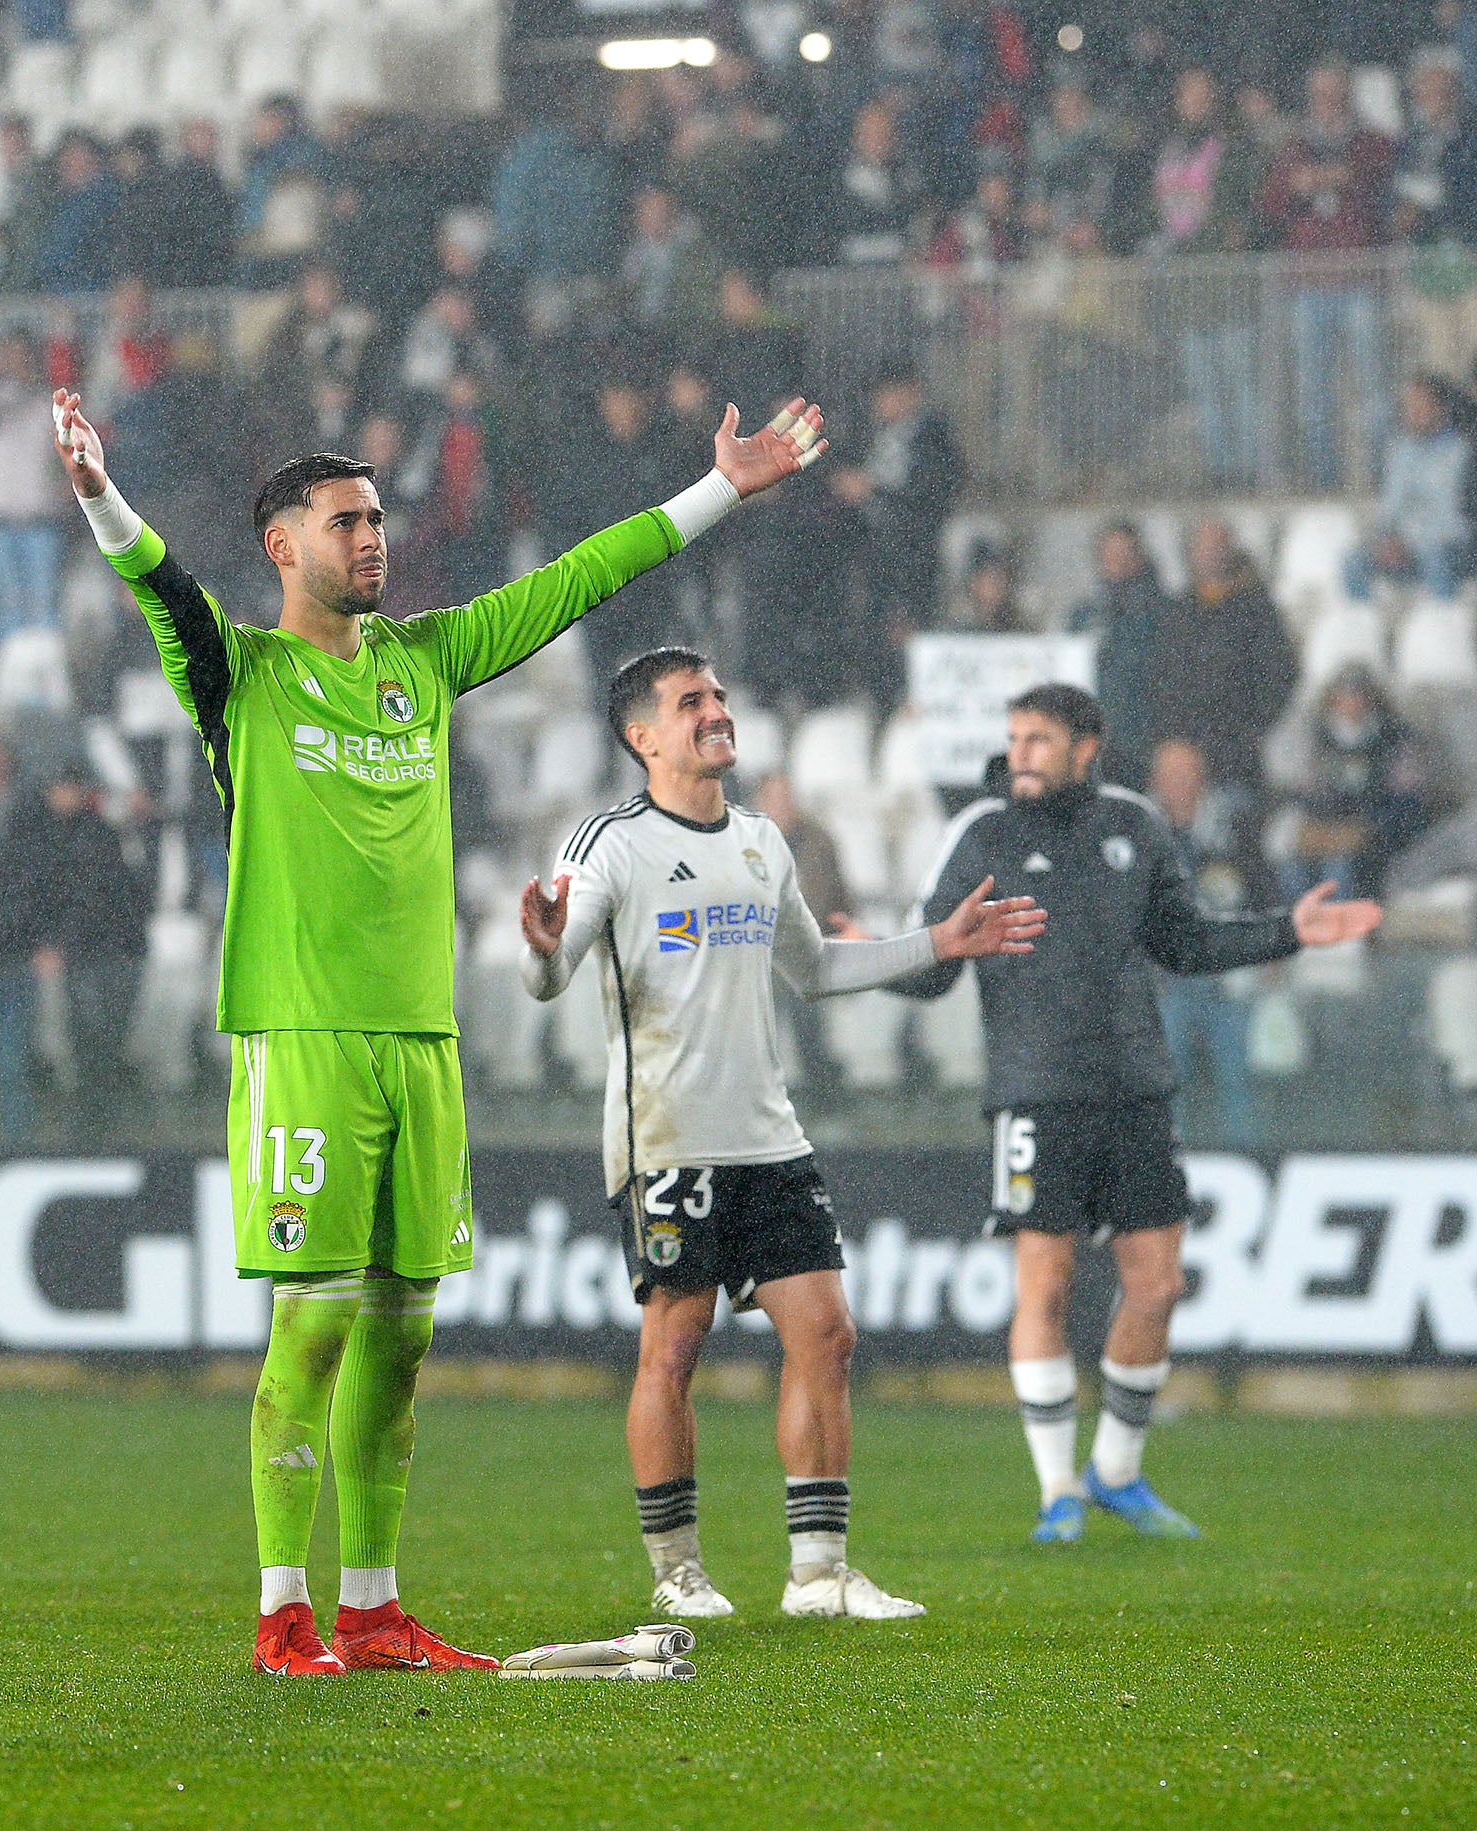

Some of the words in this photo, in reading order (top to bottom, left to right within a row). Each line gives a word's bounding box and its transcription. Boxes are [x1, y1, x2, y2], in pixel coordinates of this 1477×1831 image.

[343, 735, 436, 762] REALE
[344, 761, 436, 783] SEGUROS
[266, 1126, 327, 1195] 13
[1008, 1118, 1036, 1172] 5
[645, 1168, 714, 1219] 23
